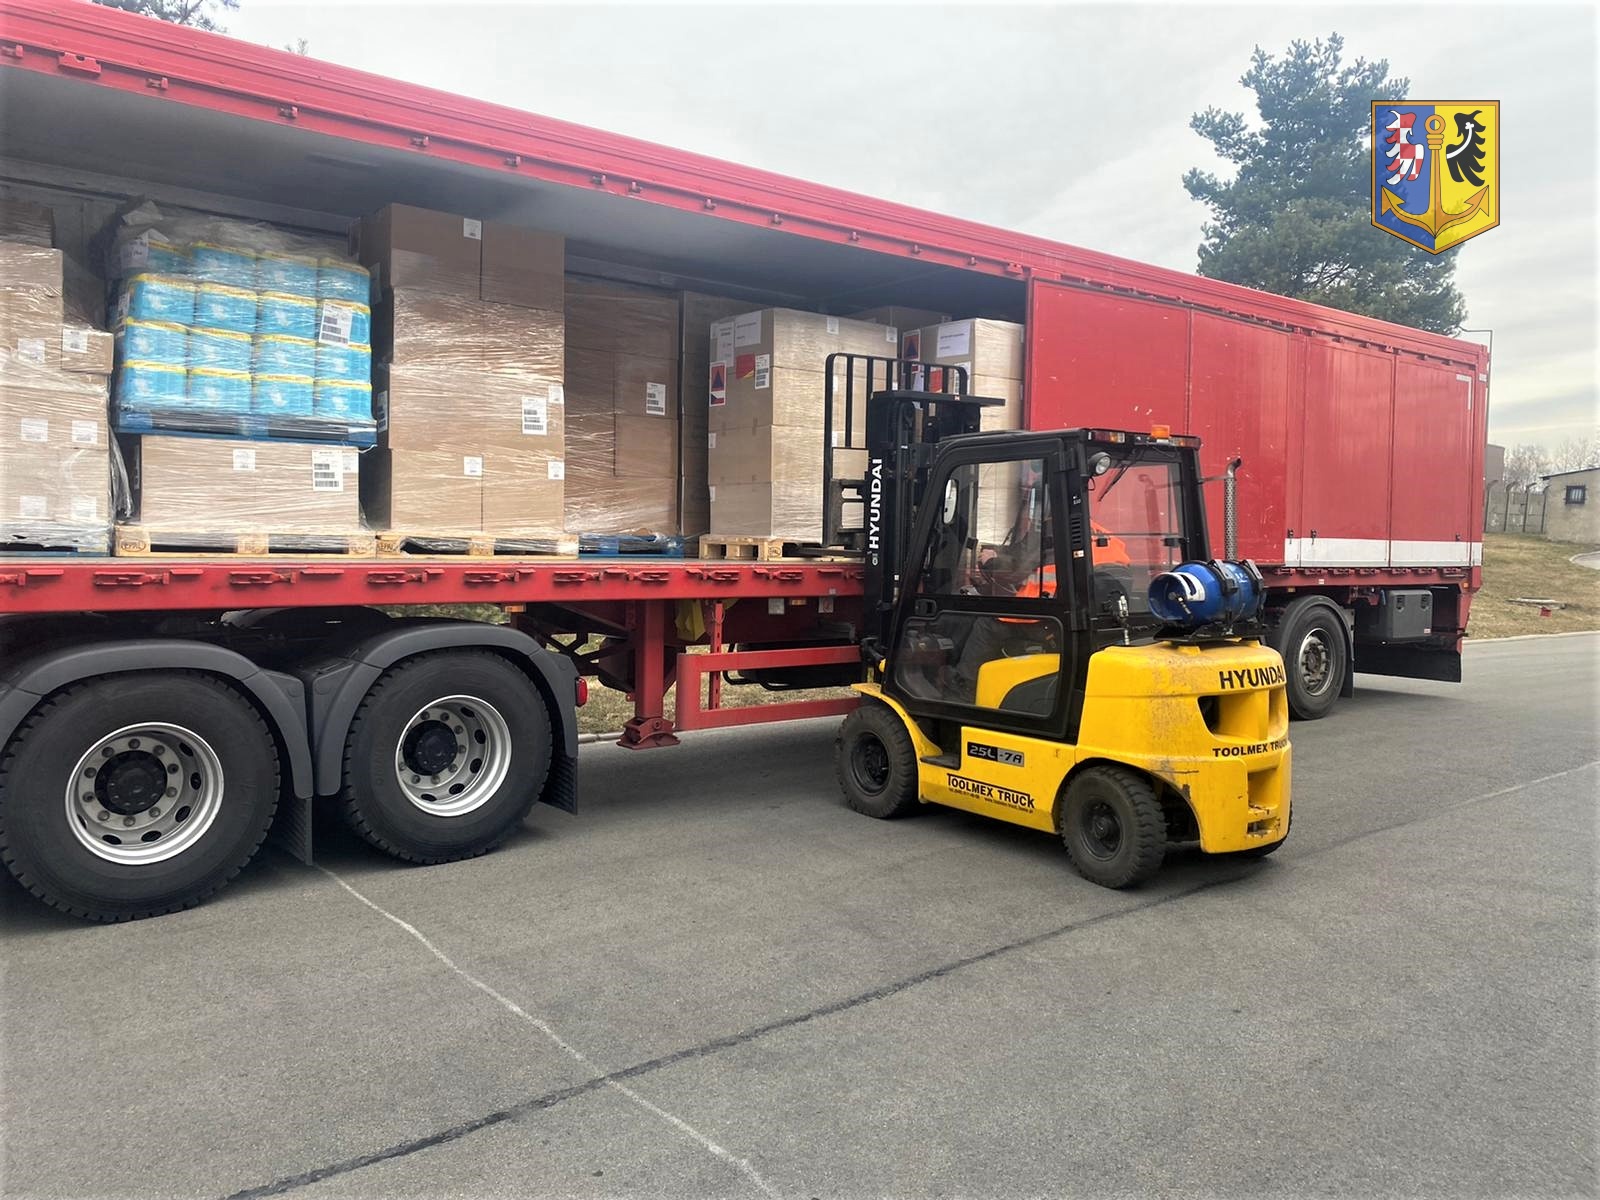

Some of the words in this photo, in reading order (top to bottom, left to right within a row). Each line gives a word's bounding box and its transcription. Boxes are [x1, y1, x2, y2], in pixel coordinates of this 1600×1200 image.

[869, 459, 882, 549] HYUNDAI
[1212, 744, 1268, 757] TOOLMEX
[946, 773, 993, 798] TOOLMEX
[998, 789, 1035, 808] TRUCK
